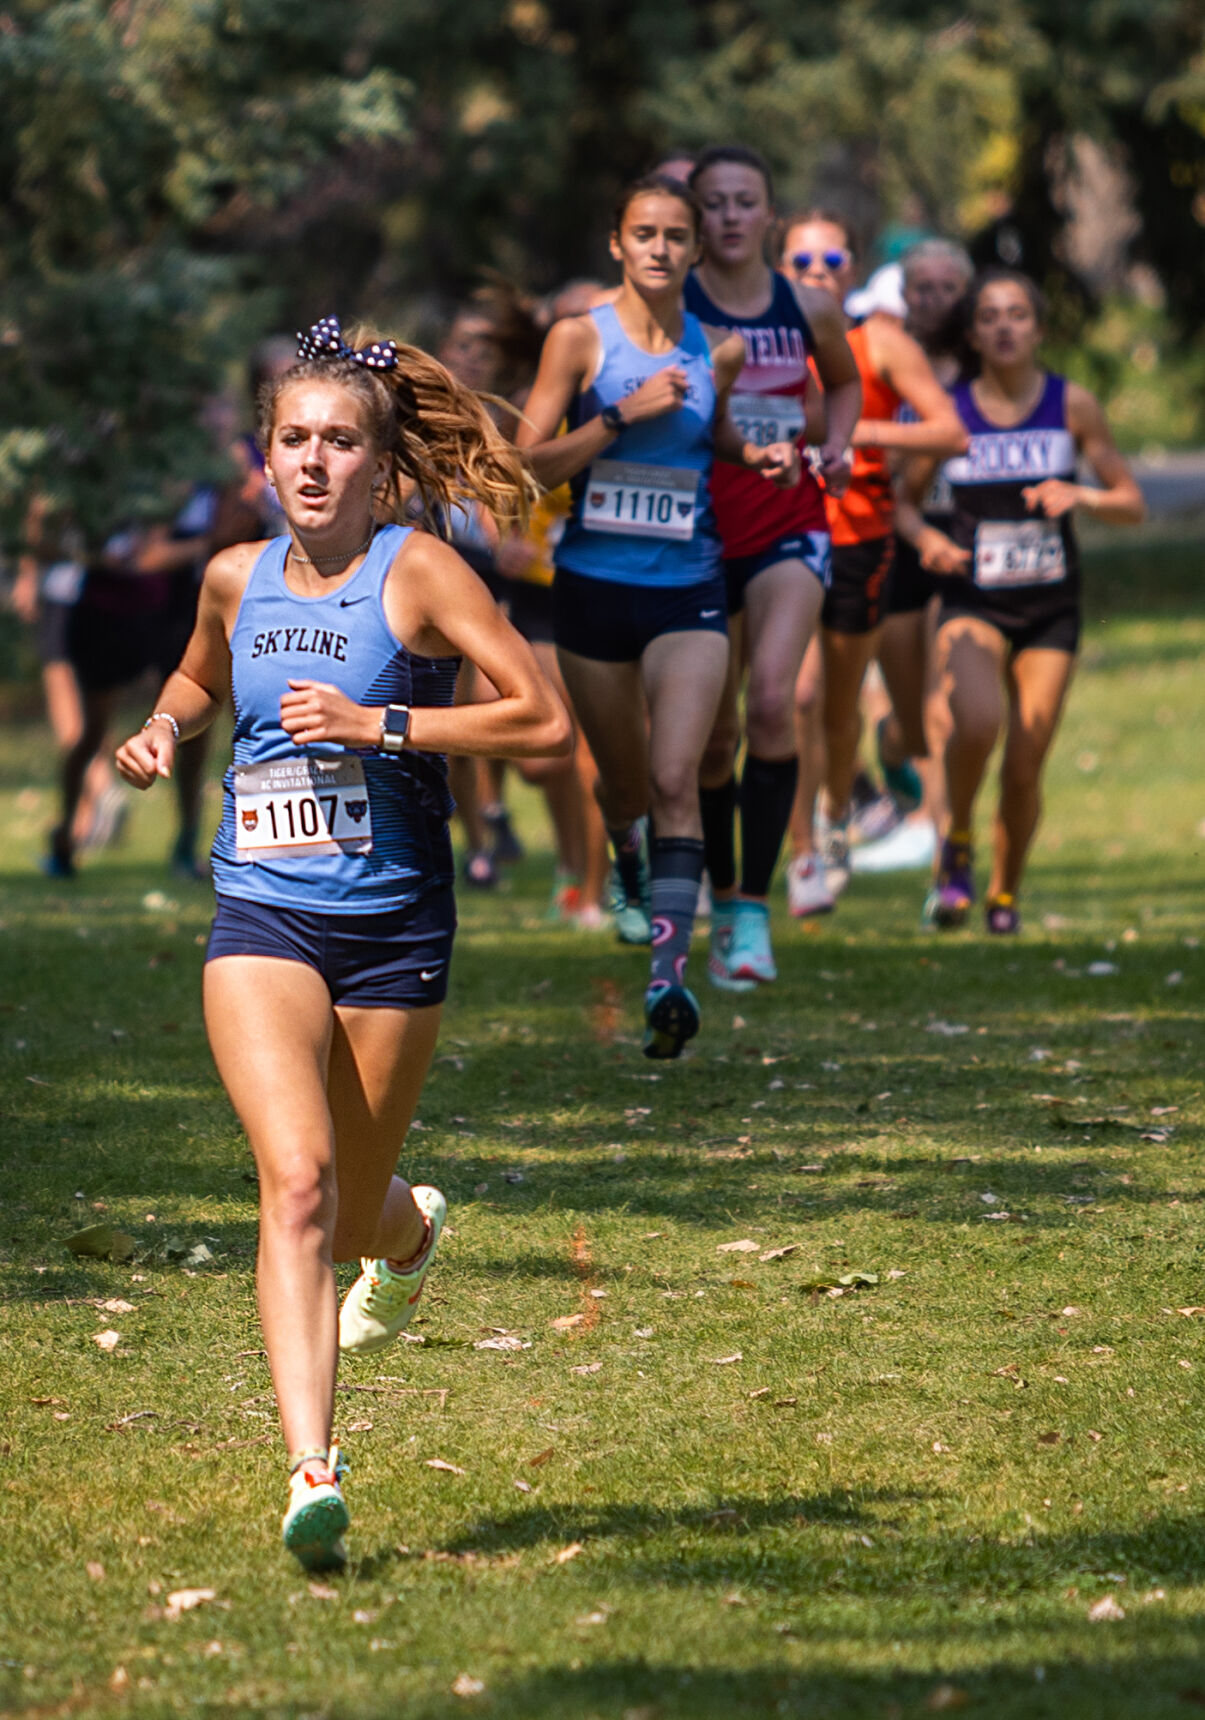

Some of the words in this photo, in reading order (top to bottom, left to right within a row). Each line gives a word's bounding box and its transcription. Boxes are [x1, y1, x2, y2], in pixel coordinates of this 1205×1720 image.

[615, 488, 673, 523] 1110
[251, 627, 348, 662] SKYLINE
[265, 793, 338, 839] 1107
